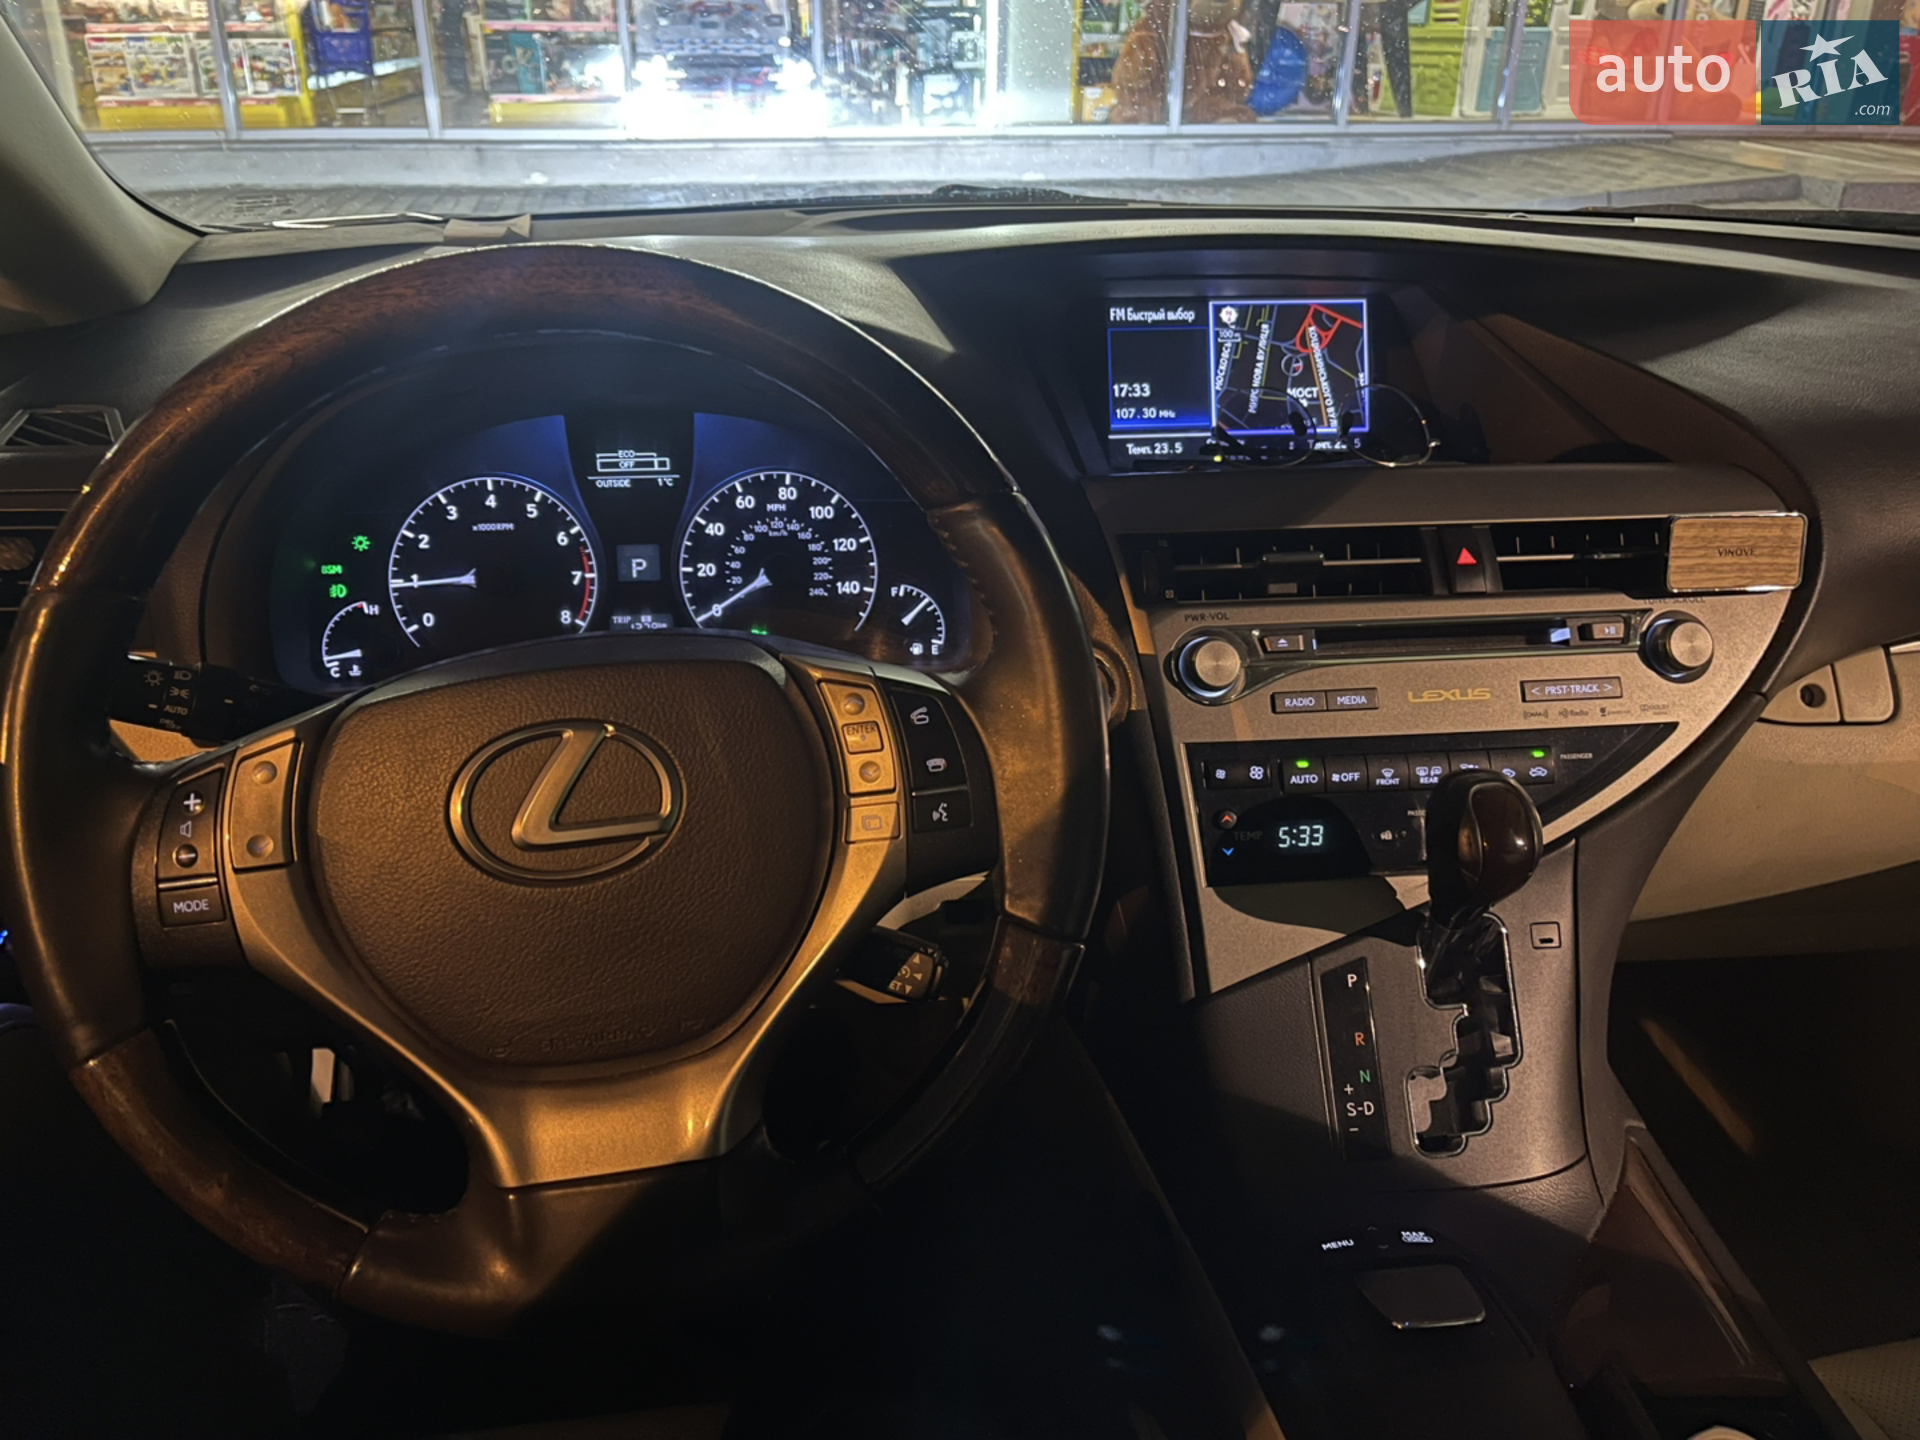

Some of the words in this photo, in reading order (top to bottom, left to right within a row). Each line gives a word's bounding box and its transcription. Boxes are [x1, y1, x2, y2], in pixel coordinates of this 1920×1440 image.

[1110, 308, 1125, 321] FM
[1127, 307, 1166, 323] Быстрый
[1167, 307, 1195, 323] выбор
[1113, 384, 1151, 397] 17:33
[1287, 387, 1319, 399] МОСТ
[618, 450, 635, 458] ECO
[619, 461, 635, 469] OFF
[596, 479, 631, 488] OUTSIDE
[778, 487, 797, 500] 80
[485, 494, 497, 508] 4
[735, 496, 755, 509] 60
[446, 506, 458, 520] 3
[526, 504, 538, 518] 5
[766, 504, 786, 512] MPH
[809, 506, 834, 519] 100
[705, 523, 725, 536] 40
[770, 521, 784, 529] 120
[418, 534, 430, 548] 2
[557, 533, 569, 546] 6
[833, 538, 857, 551] 120
[631, 558, 646, 578] P
[697, 563, 716, 577] 20
[571, 571, 582, 585] 7
[836, 581, 861, 594] 140
[891, 586, 899, 597] F
[368, 604, 379, 615] H
[423, 613, 435, 627] 0
[560, 611, 571, 624] 8
[931, 644, 939, 655] E
[330, 667, 340, 678] C
[1284, 697, 1315, 707] RADIO
[1336, 695, 1367, 705] MEDIA
[1408, 688, 1491, 703] LEXUS
[163, 704, 188, 715] AUTO
[846, 724, 876, 736] ENTER
[1290, 774, 1318, 784] AUTO
[1340, 772, 1361, 782] OFF
[1376, 778, 1400, 786] FRONT
[1233, 831, 1263, 841] TEMP
[1278, 824, 1324, 848] 5:33
[173, 899, 209, 914] MODE
[1347, 973, 1357, 988] P
[1354, 1032, 1365, 1046] R
[1359, 1069, 1371, 1083] N
[1321, 1239, 1354, 1251] MENU
